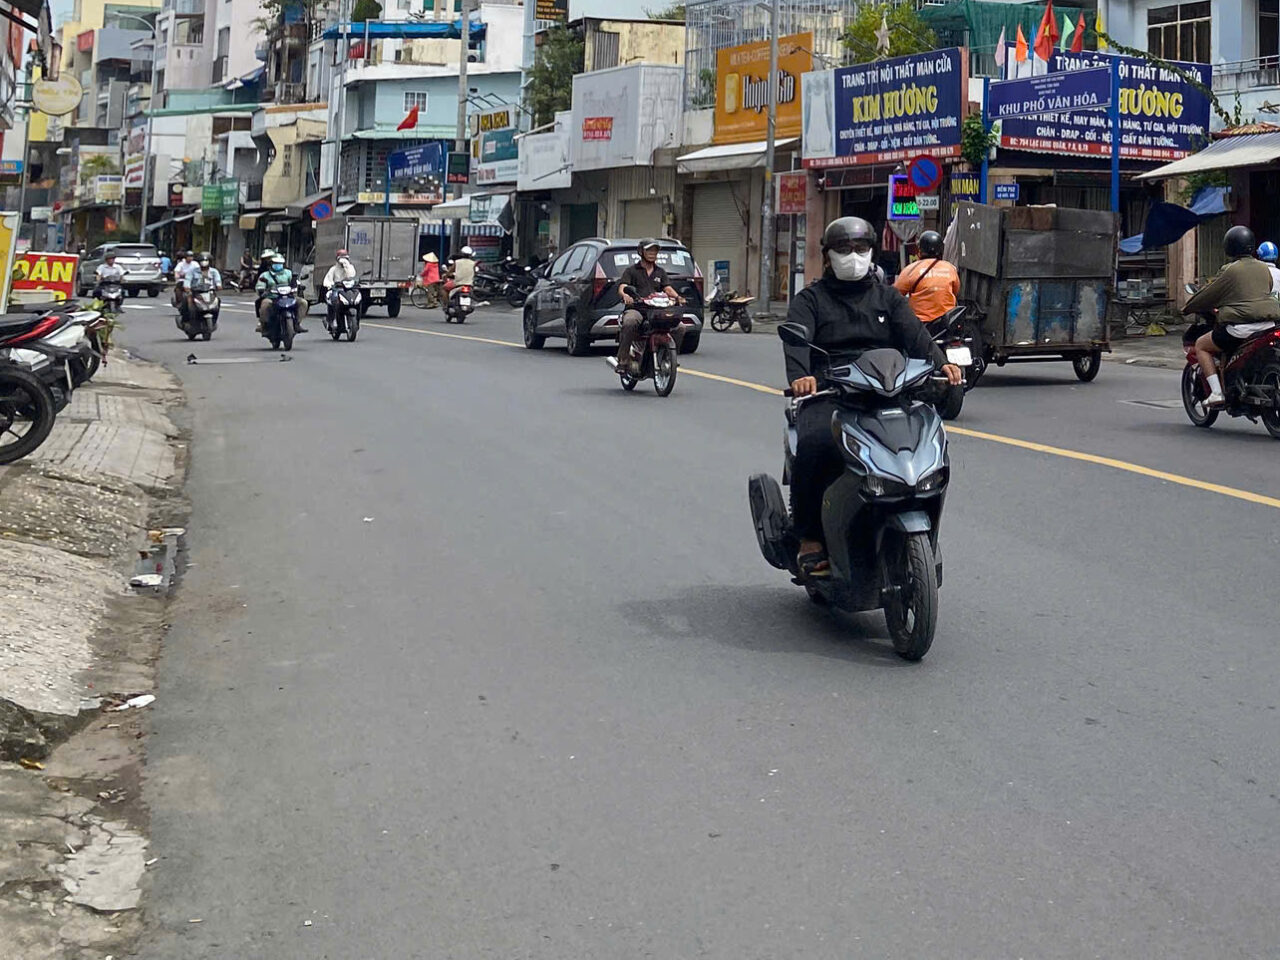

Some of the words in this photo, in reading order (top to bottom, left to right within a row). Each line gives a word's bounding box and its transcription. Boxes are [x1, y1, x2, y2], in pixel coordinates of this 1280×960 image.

[842, 71, 865, 88] TRANG
[866, 66, 878, 84] TRÍ
[880, 64, 893, 84] NỘI
[894, 58, 914, 78] THẤT
[916, 56, 934, 76] MÀN
[935, 52, 952, 73] CỬA
[1131, 61, 1157, 80] THẤT
[743, 72, 771, 113] Huỳn
[852, 93, 881, 123] KIM
[882, 82, 939, 119] HƯƠNG
[999, 103, 1020, 115] KHU
[1023, 96, 1045, 112] PHỐ
[1048, 96, 1070, 109] VĂN
[1073, 91, 1098, 106] HÓA
